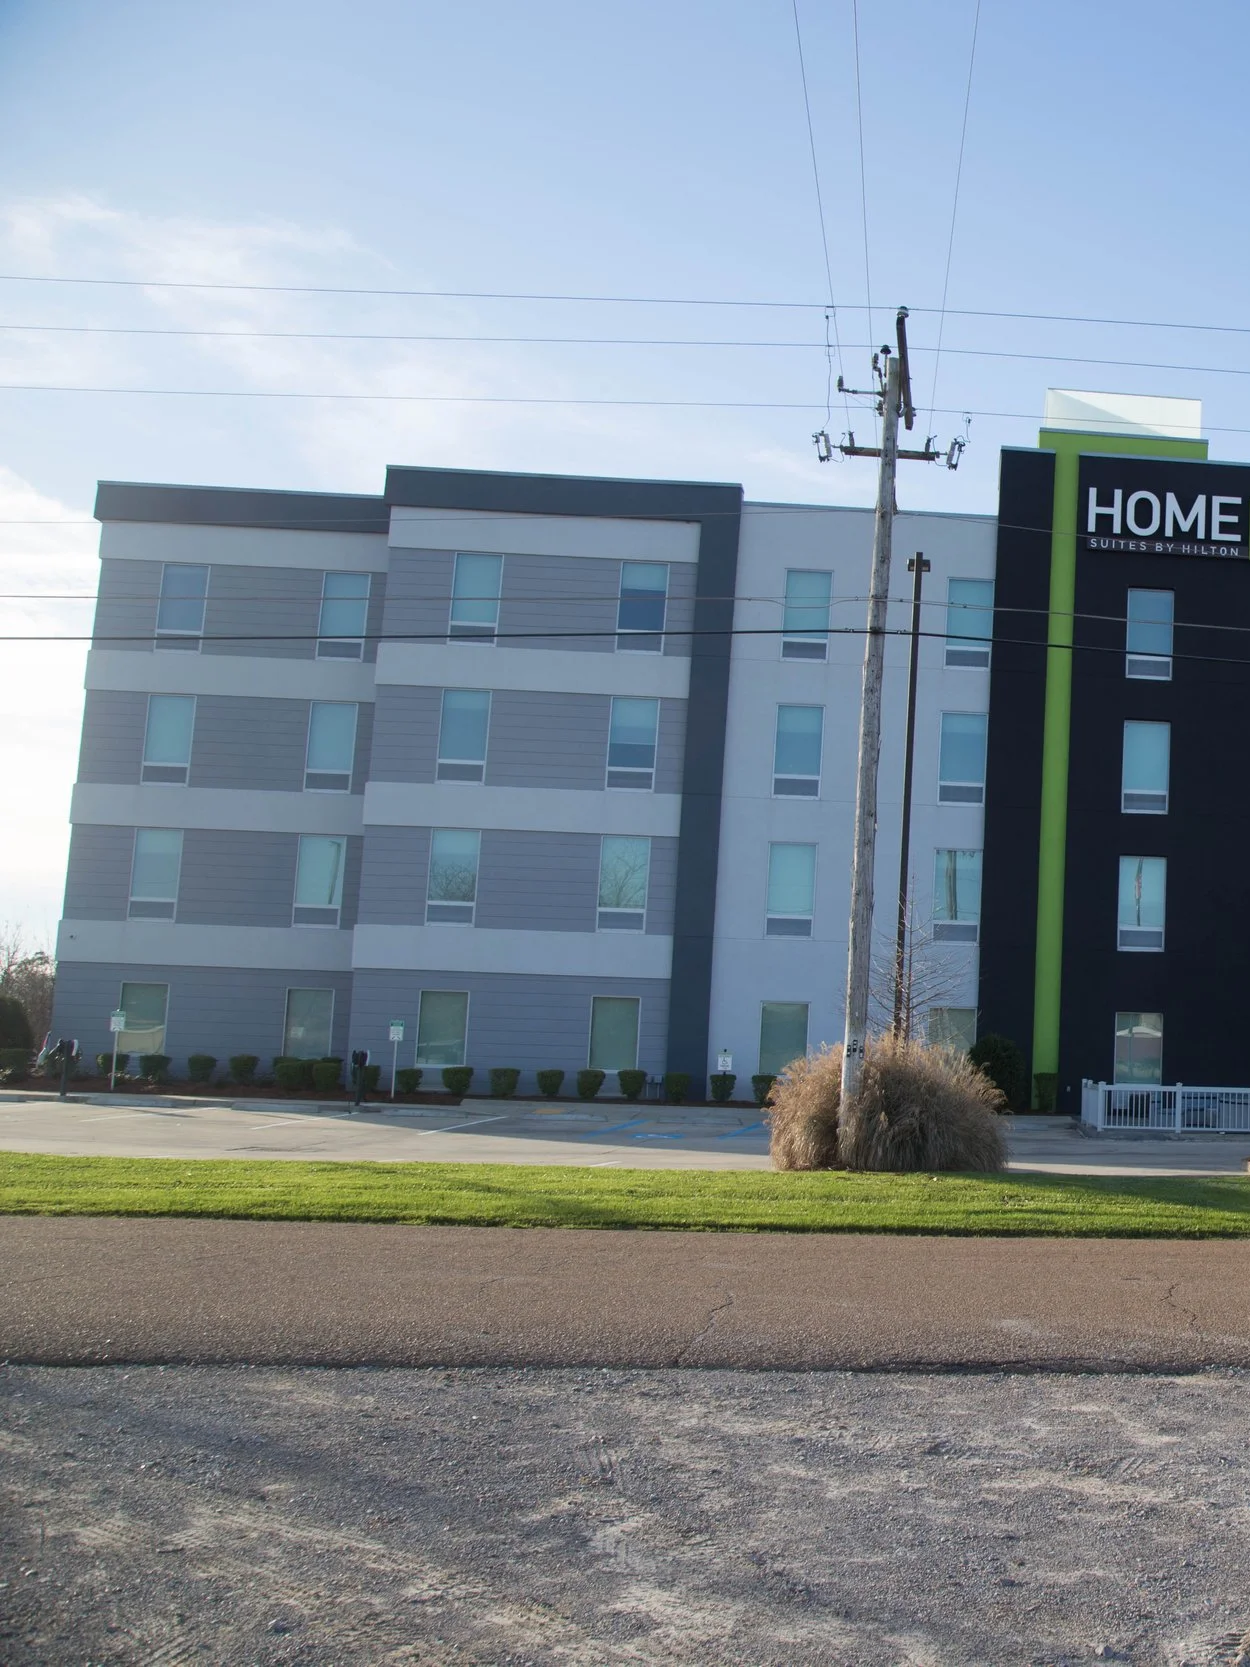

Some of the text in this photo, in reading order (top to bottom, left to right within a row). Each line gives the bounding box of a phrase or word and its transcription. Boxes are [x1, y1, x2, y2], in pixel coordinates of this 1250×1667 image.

[1087, 487, 1242, 541] HOME
[1090, 538, 1239, 556] SUITES BY HILTON
